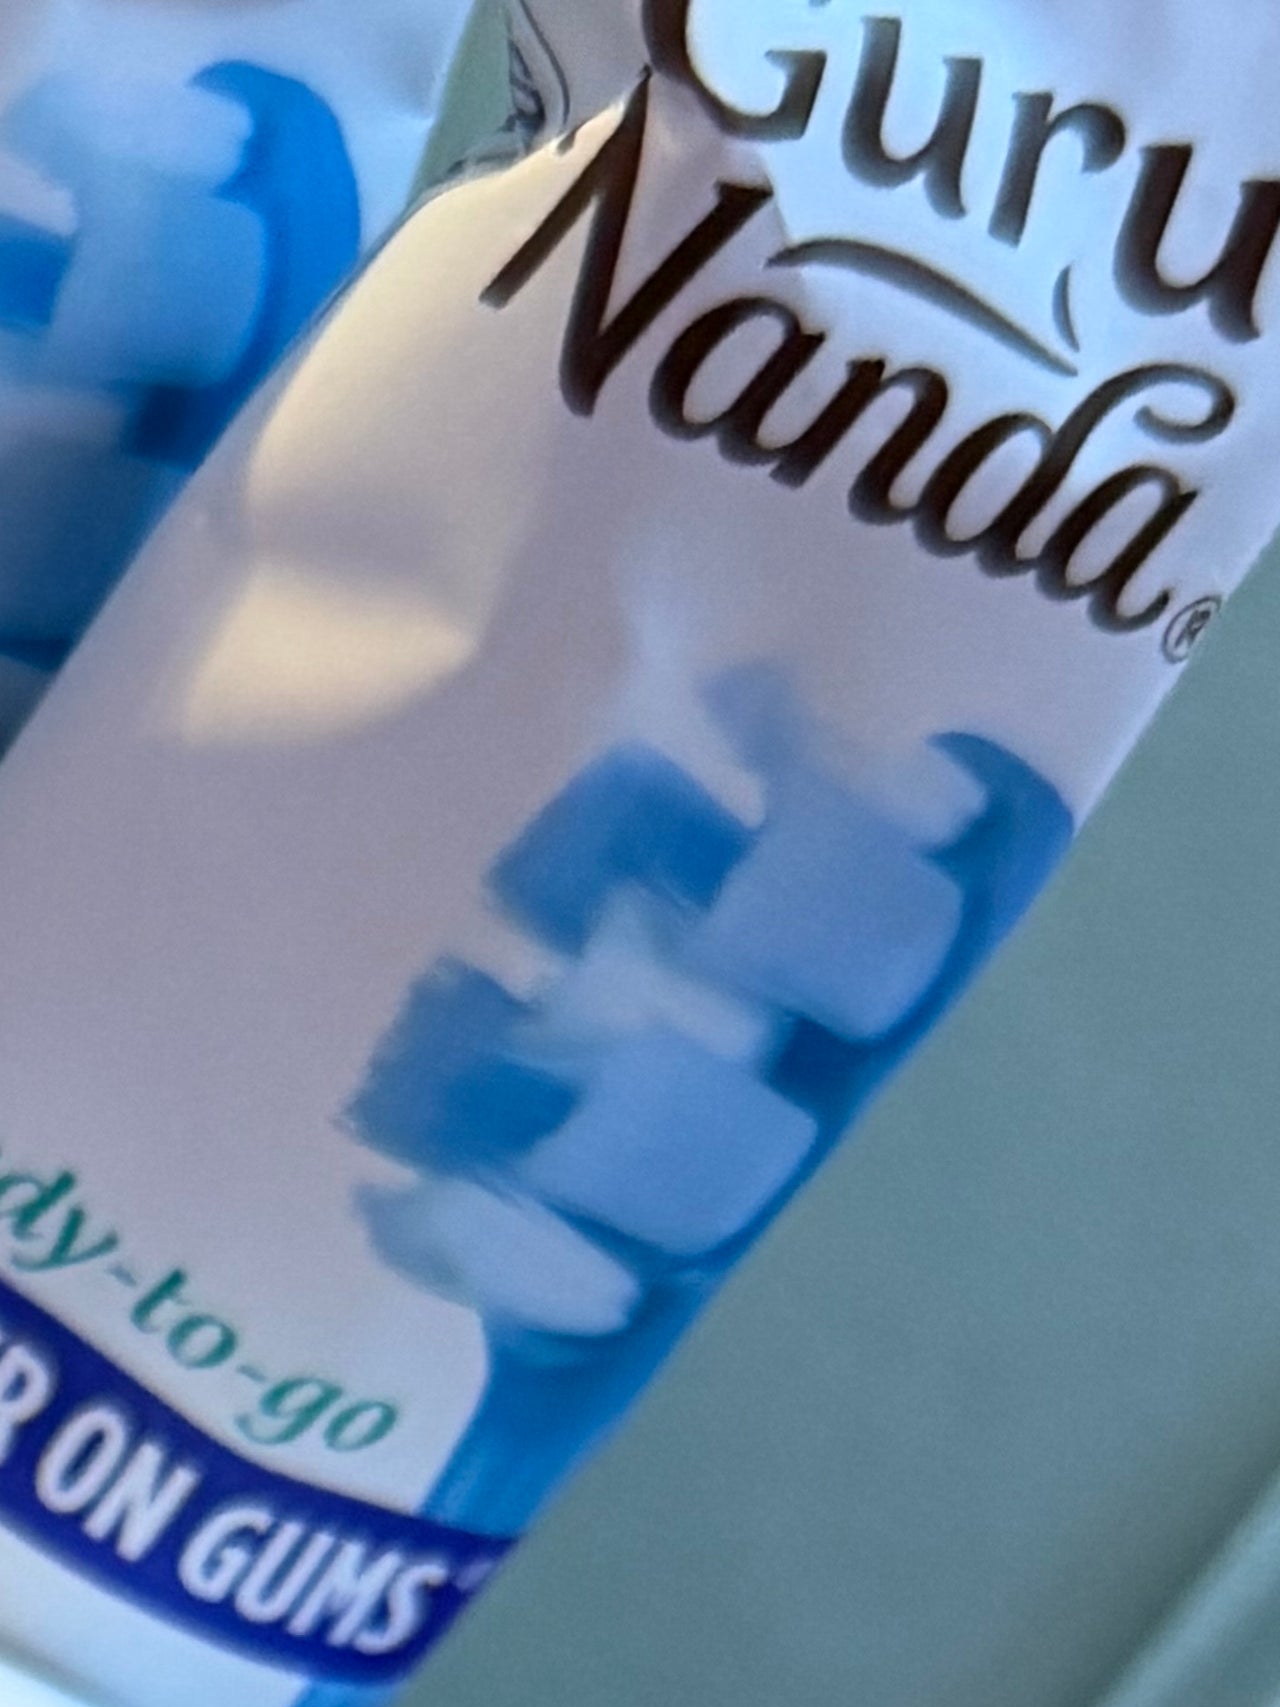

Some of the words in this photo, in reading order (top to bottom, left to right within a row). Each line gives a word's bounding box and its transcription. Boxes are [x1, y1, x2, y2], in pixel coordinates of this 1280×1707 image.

[642, 0, 1280, 342] Guru
[478, 64, 1237, 634] Nanda
[38, 1404, 201, 1563] ON
[176, 1502, 449, 1656] GUMS
